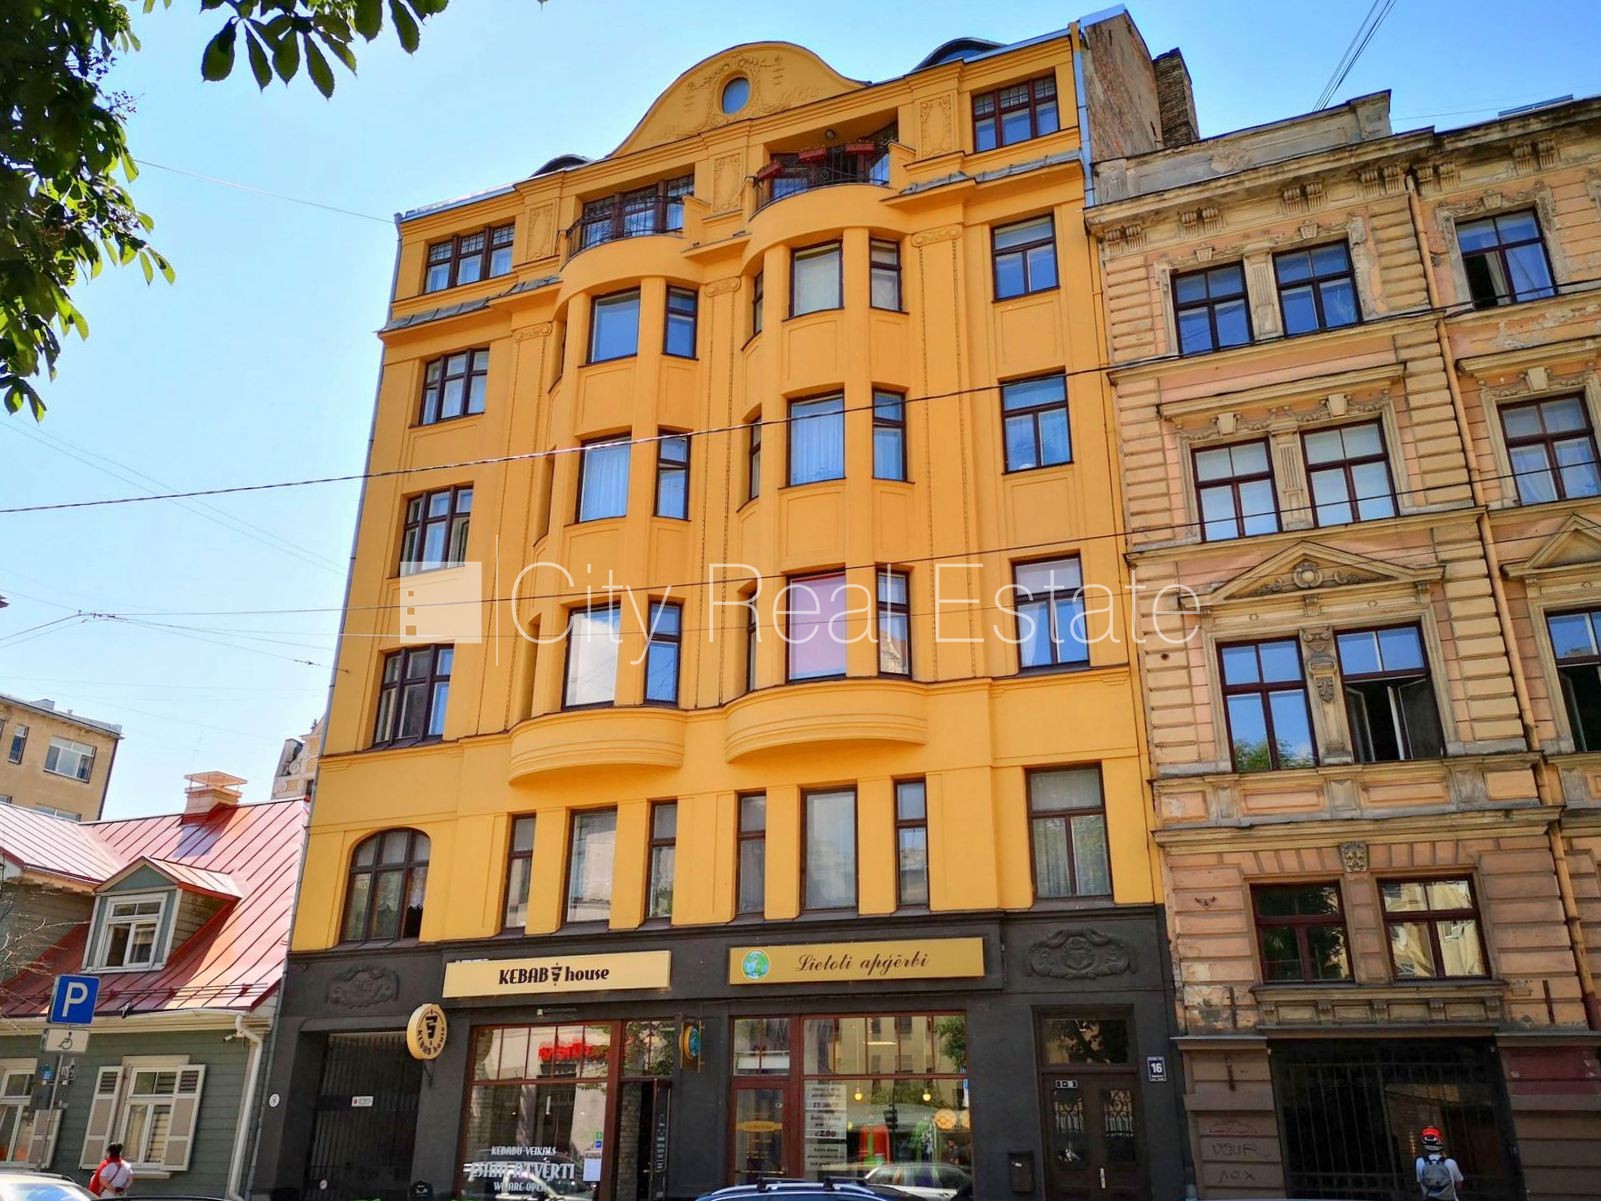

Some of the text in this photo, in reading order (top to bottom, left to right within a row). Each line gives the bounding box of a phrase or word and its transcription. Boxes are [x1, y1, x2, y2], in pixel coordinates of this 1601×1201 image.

[498, 966, 610, 985] KEBAB house
[62, 982, 88, 1017] P
[1150, 1062, 1163, 1074] 16
